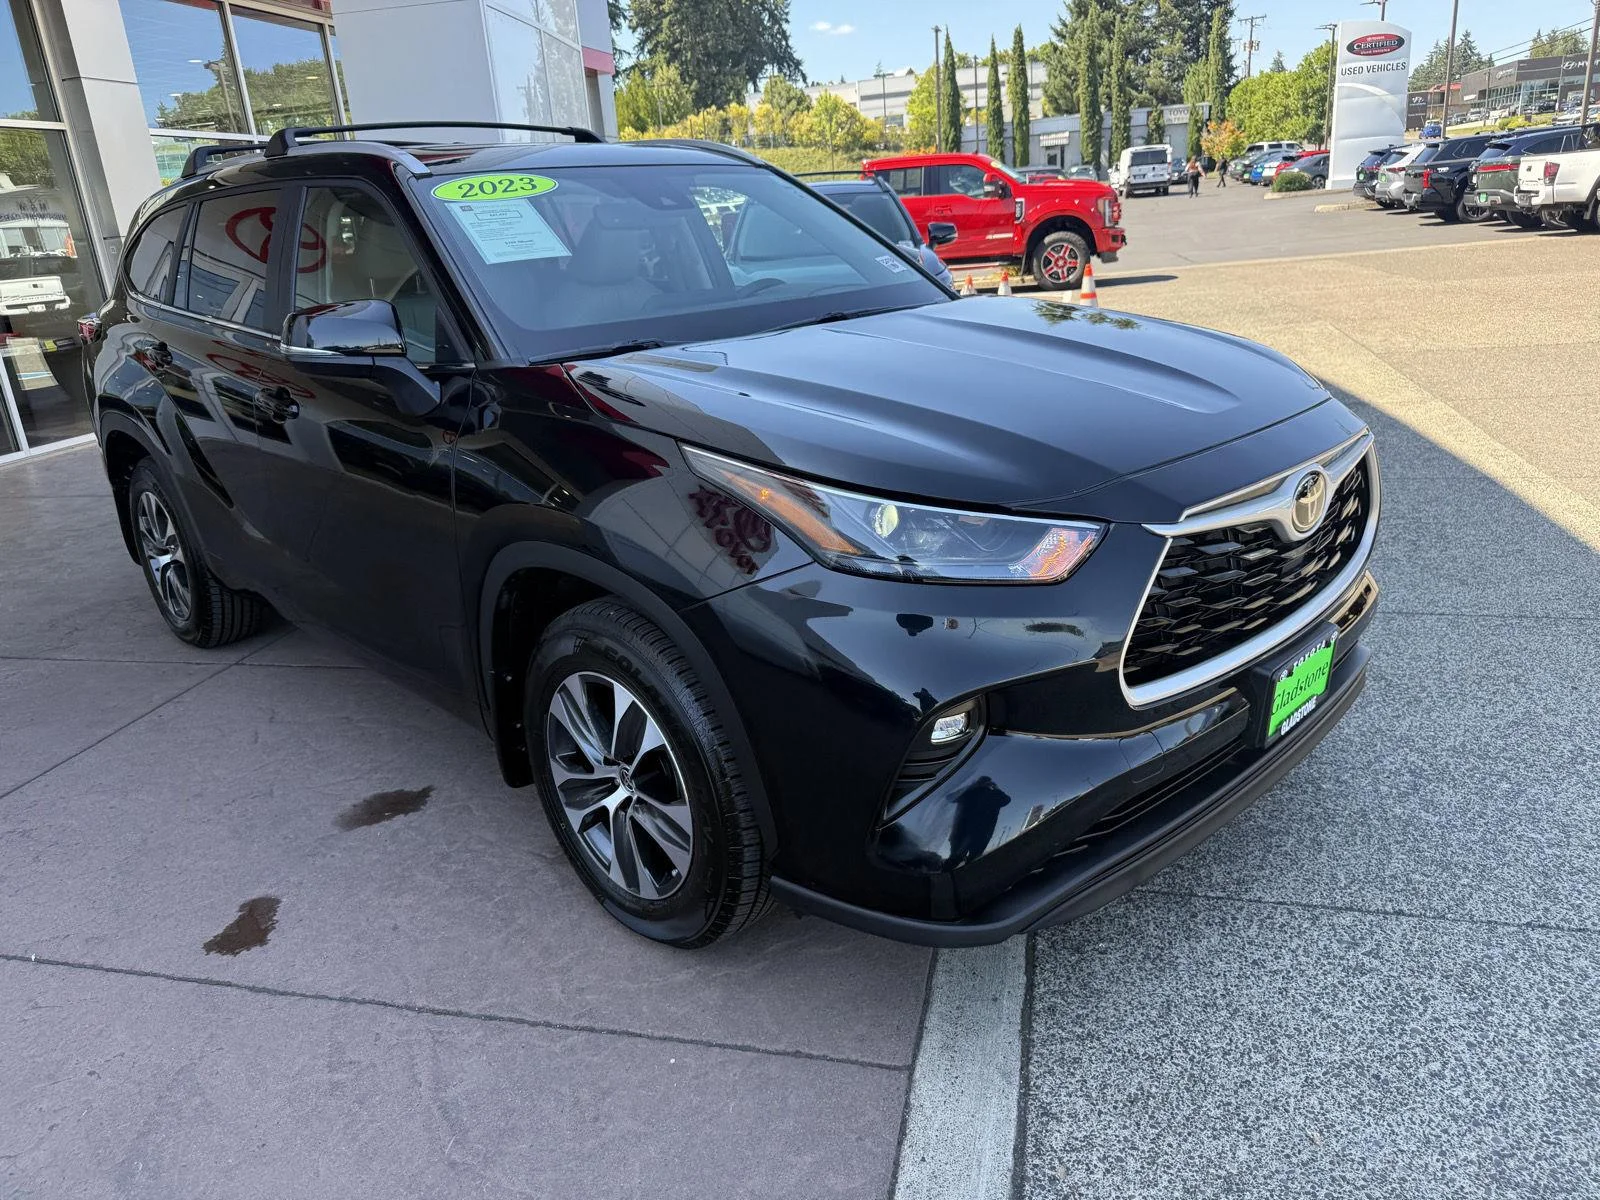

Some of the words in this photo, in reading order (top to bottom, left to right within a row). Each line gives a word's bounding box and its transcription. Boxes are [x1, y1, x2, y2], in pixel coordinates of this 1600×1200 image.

[1341, 66, 1364, 76] USED
[1366, 61, 1407, 74] VEHICLES
[457, 177, 538, 198] 2023
[1293, 640, 1327, 670] TOYOTA
[1272, 660, 1329, 715] Gladstone
[1280, 696, 1317, 735] GLADSTONE
